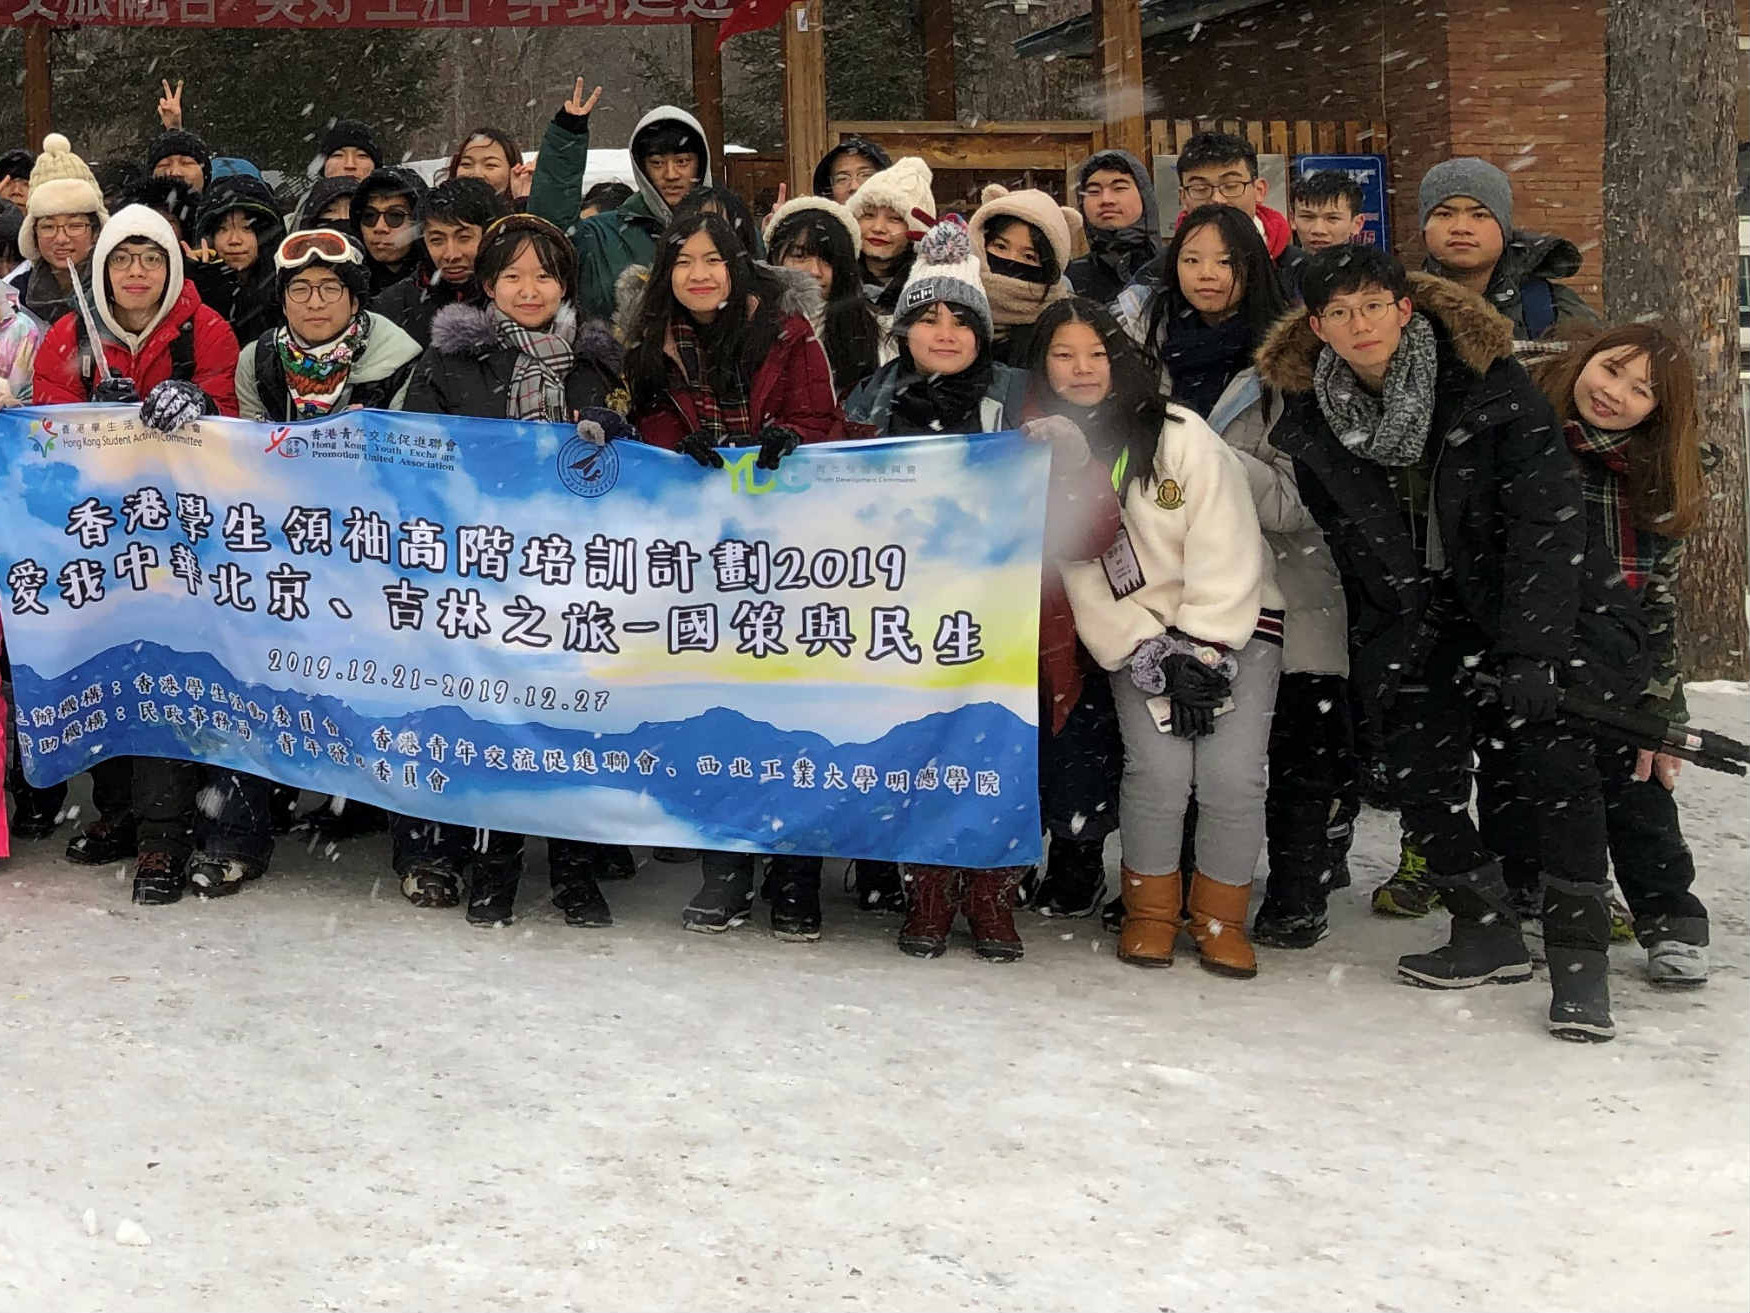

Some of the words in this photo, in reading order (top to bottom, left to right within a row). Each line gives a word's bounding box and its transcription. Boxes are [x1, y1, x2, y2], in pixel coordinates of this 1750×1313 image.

[63, 438, 82, 450] Hong
[82, 436, 101, 449] Kong
[101, 435, 131, 447] Student
[133, 430, 160, 443] Activity
[161, 431, 203, 448] Committee
[312, 440, 336, 450] Hong
[344, 441, 367, 453] Kong
[374, 444, 402, 455] Youth
[312, 450, 360, 460] Promotion
[363, 453, 394, 465] United
[399, 457, 455, 472] Association
[66, 485, 906, 592] 香港學生領袖高階培訓計劃2019
[268, 648, 611, 713] 2019.12.21-2019.12.27
